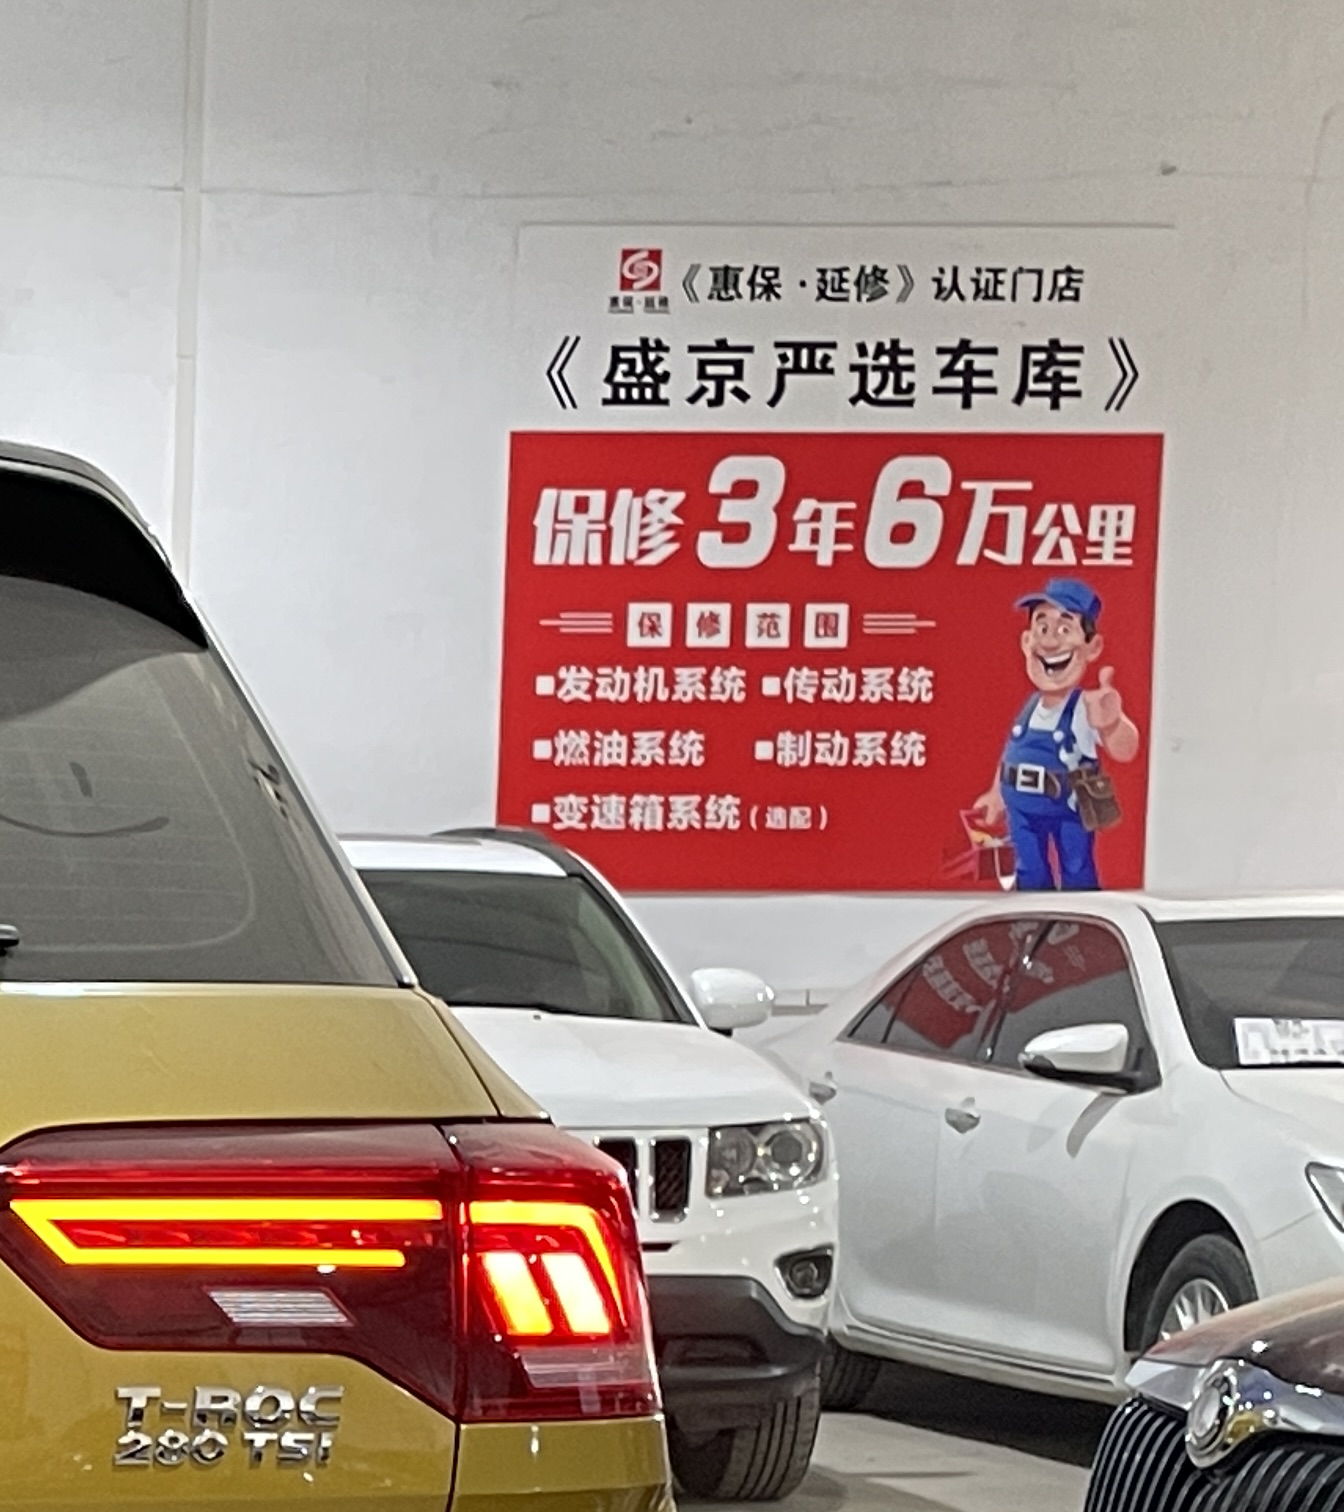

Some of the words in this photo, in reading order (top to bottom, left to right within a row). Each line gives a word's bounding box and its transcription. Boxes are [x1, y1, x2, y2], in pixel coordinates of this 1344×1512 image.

[546, 335, 1139, 411] 《盛京严选车库》
[533, 455, 1136, 568] 保修3年6万公里
[637, 611, 842, 640] 保修范围
[555, 666, 747, 703] 发动机系统
[784, 667, 934, 704] 传动系统
[553, 731, 705, 767] 燃油系统
[776, 731, 926, 767] 制动系统
[116, 1385, 345, 1428] T-ROC
[115, 1430, 229, 1466] 280
[243, 1432, 332, 1466] TSI
